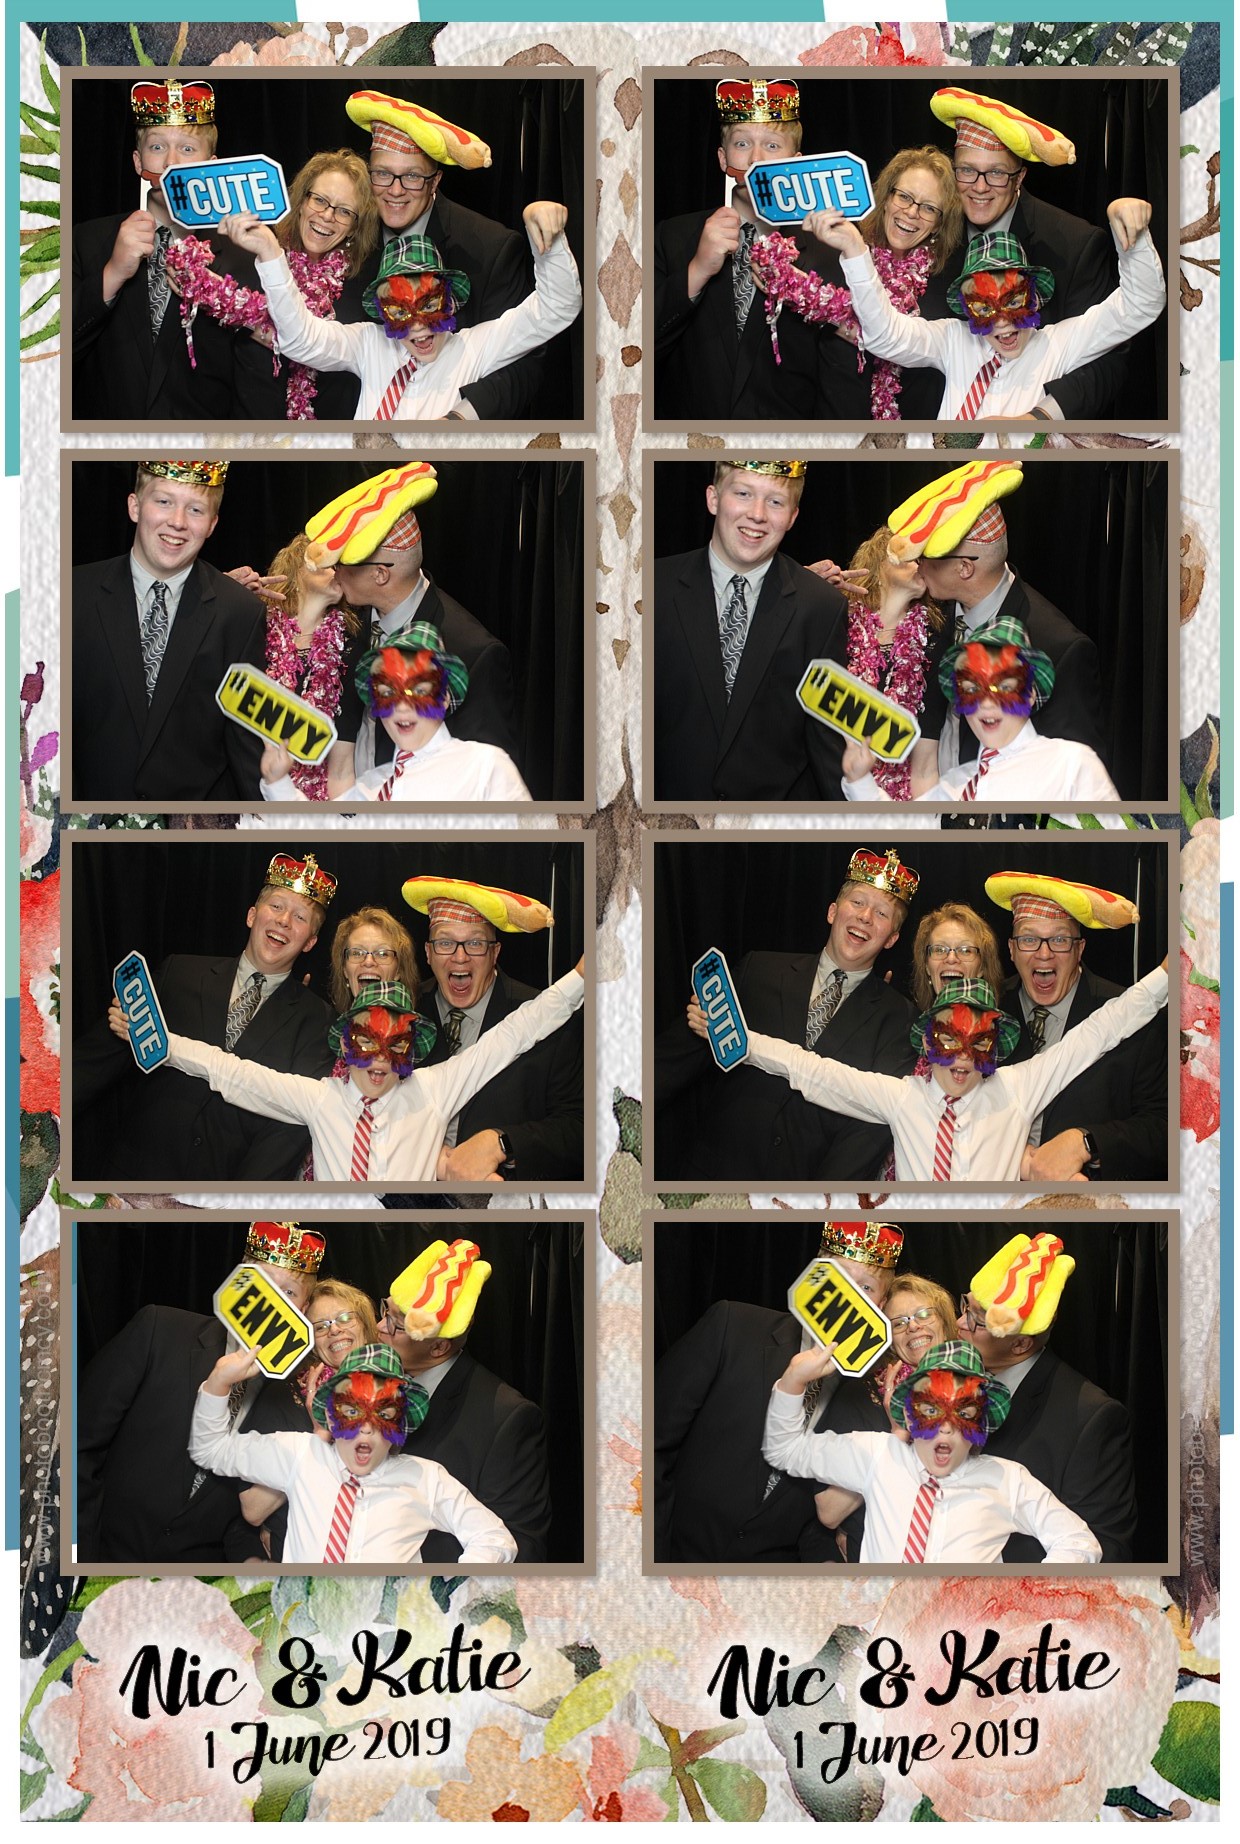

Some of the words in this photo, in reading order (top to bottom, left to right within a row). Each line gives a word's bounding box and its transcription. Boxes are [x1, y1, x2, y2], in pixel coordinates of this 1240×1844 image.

[170, 171, 276, 216] #CUTE
[755, 167, 860, 213] #CUTE
[120, 960, 163, 1061] #CUTE
[700, 957, 742, 1059] #CUTE
